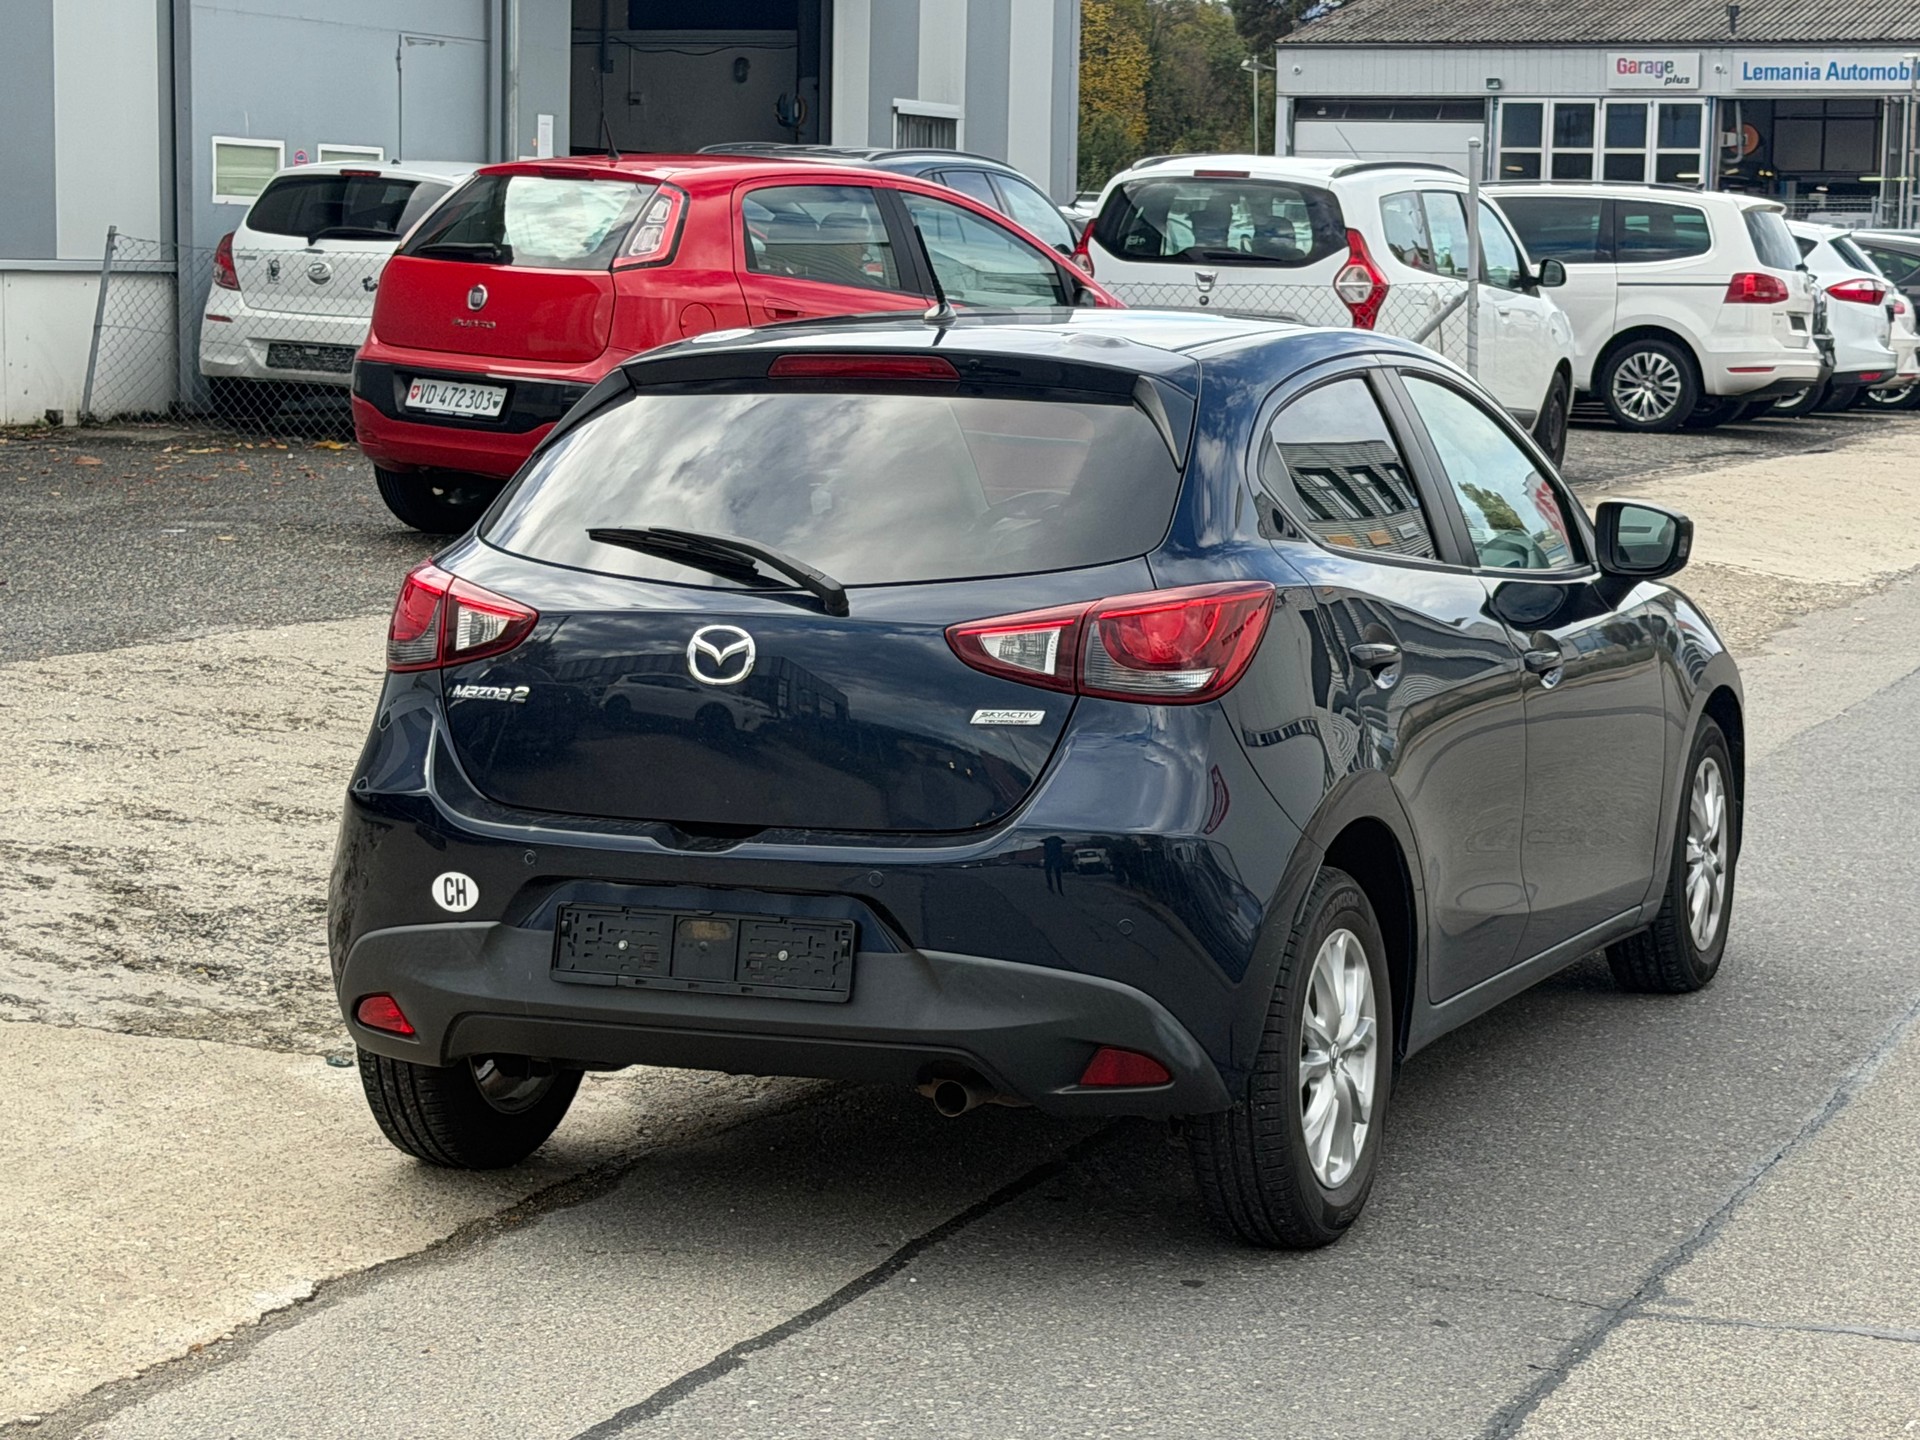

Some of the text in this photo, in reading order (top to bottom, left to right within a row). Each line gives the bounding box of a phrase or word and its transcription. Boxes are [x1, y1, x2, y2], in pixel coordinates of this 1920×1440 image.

[1616, 57, 1674, 79] Garage
[1743, 61, 1821, 81] Lemania
[1664, 74, 1690, 86] plus
[980, 711, 1037, 719] SKYACTIV
[443, 876, 468, 907] CH
